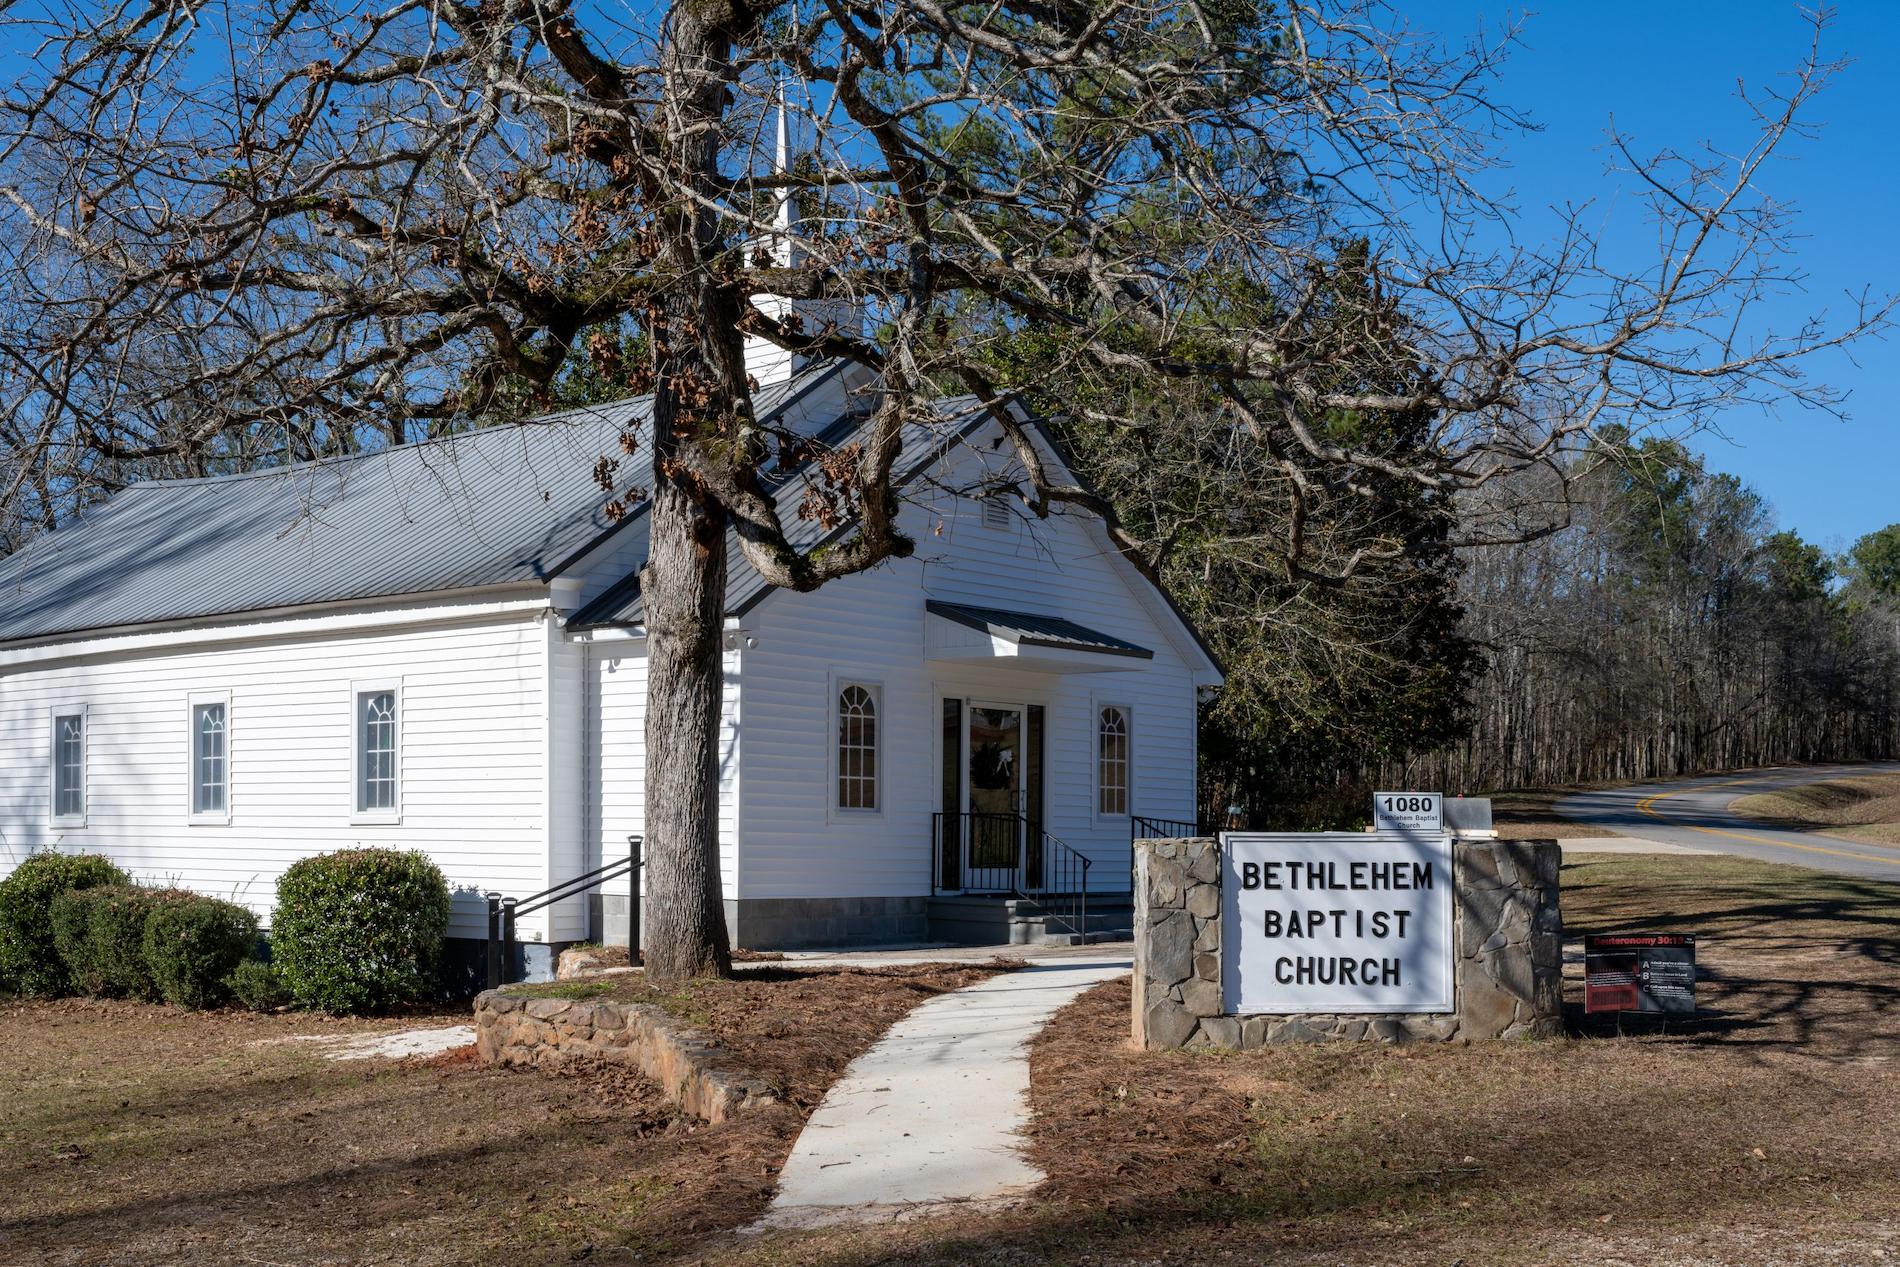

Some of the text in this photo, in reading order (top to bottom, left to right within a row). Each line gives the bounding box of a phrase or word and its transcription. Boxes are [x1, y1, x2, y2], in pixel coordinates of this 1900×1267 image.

[1384, 797, 1433, 812] 1080
[1242, 861, 1433, 890] BETHLEHEM
[1264, 910, 1412, 938] BAPTIST
[1594, 936, 1656, 946] Deuteronomy
[1275, 956, 1401, 986] CHURCH
[1643, 961, 1650, 969] A
[1643, 972, 1650, 980] B
[1643, 985, 1650, 993] C
